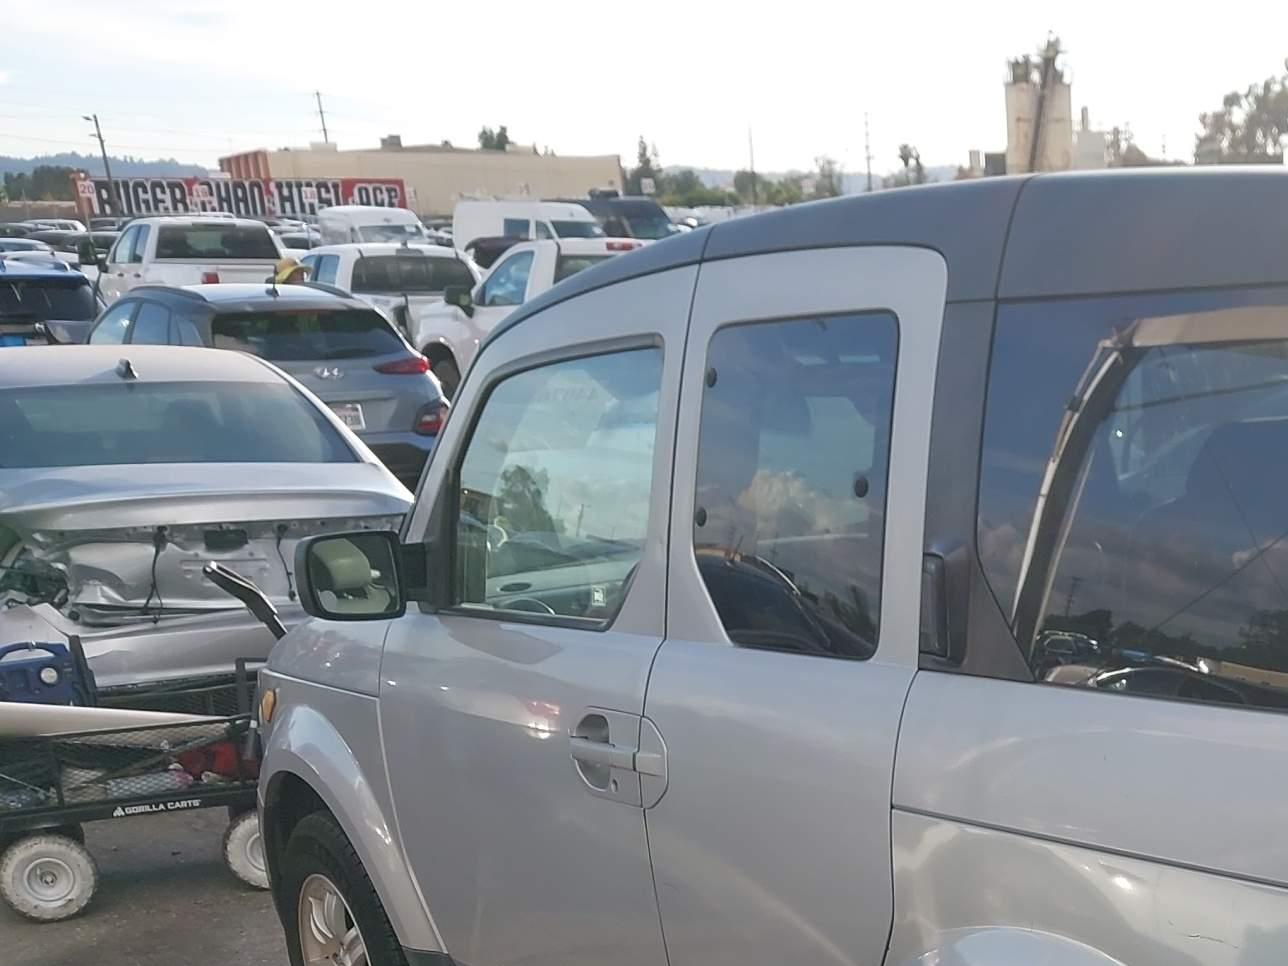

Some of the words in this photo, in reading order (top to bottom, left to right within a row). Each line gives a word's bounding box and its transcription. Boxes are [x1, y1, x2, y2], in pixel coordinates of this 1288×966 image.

[80, 184, 95, 194] 20
[125, 804, 166, 815] GORILLA
[167, 799, 201, 809] CARTS
